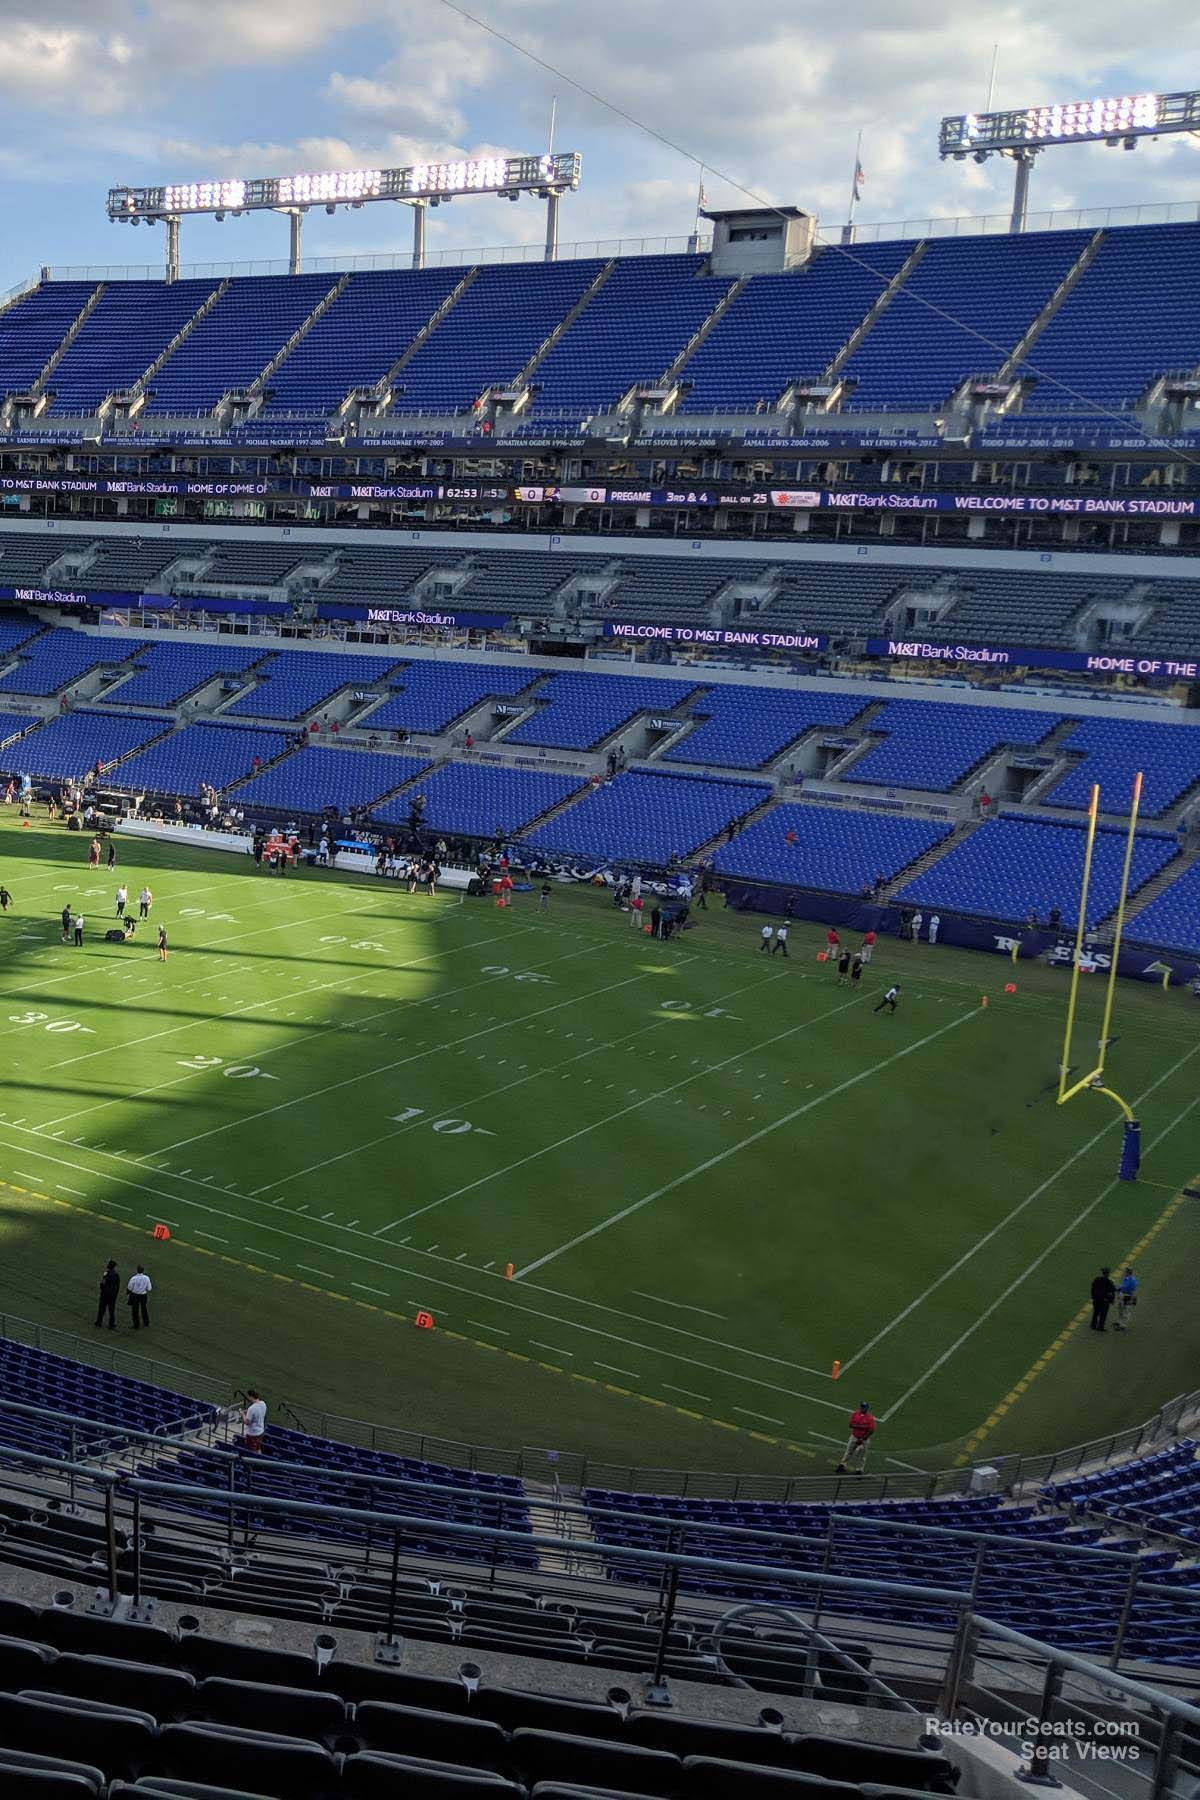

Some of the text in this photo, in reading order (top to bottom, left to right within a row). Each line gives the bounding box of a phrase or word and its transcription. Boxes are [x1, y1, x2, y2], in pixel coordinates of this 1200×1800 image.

[2, 478, 14, 488] TO
[16, 480, 34, 490] M&T
[37, 480, 59, 490] BANK
[61, 481, 97, 491] STADIUM
[107, 482, 178, 493] M&T Bank Stadium
[188, 484, 214, 493] HOME
[216, 485, 227, 493] OF
[310, 486, 333, 497] M&T
[351, 486, 433, 498] M&T Bank Stadium
[447, 488, 477, 498] 62:53
[611, 491, 651, 502] PREGAME
[667, 492, 708, 503] 3RD & 4
[753, 494, 767, 503] 25
[828, 493, 859, 505] M&T
[859, 494, 888, 506] Bank
[888, 495, 937, 508] Stadium
[955, 497, 1194, 514] WELCOME TO M&T BANK STADIUM
[16, 589, 86, 603] M&T Bank Stadium
[368, 609, 455, 624] M&T Bank Stadium
[612, 624, 818, 648] WELCOME TO M&T BANK STADIUM
[888, 641, 1008, 663] M&T Bank Stadium
[1088, 656, 1197, 676] HOME OF THE
[351, 829, 370, 837] PLAY
[9, 1012, 81, 1032] 30
[176, 1055, 260, 1079] 20
[385, 1107, 472, 1134] 10
[419, 1313, 428, 1327] G
